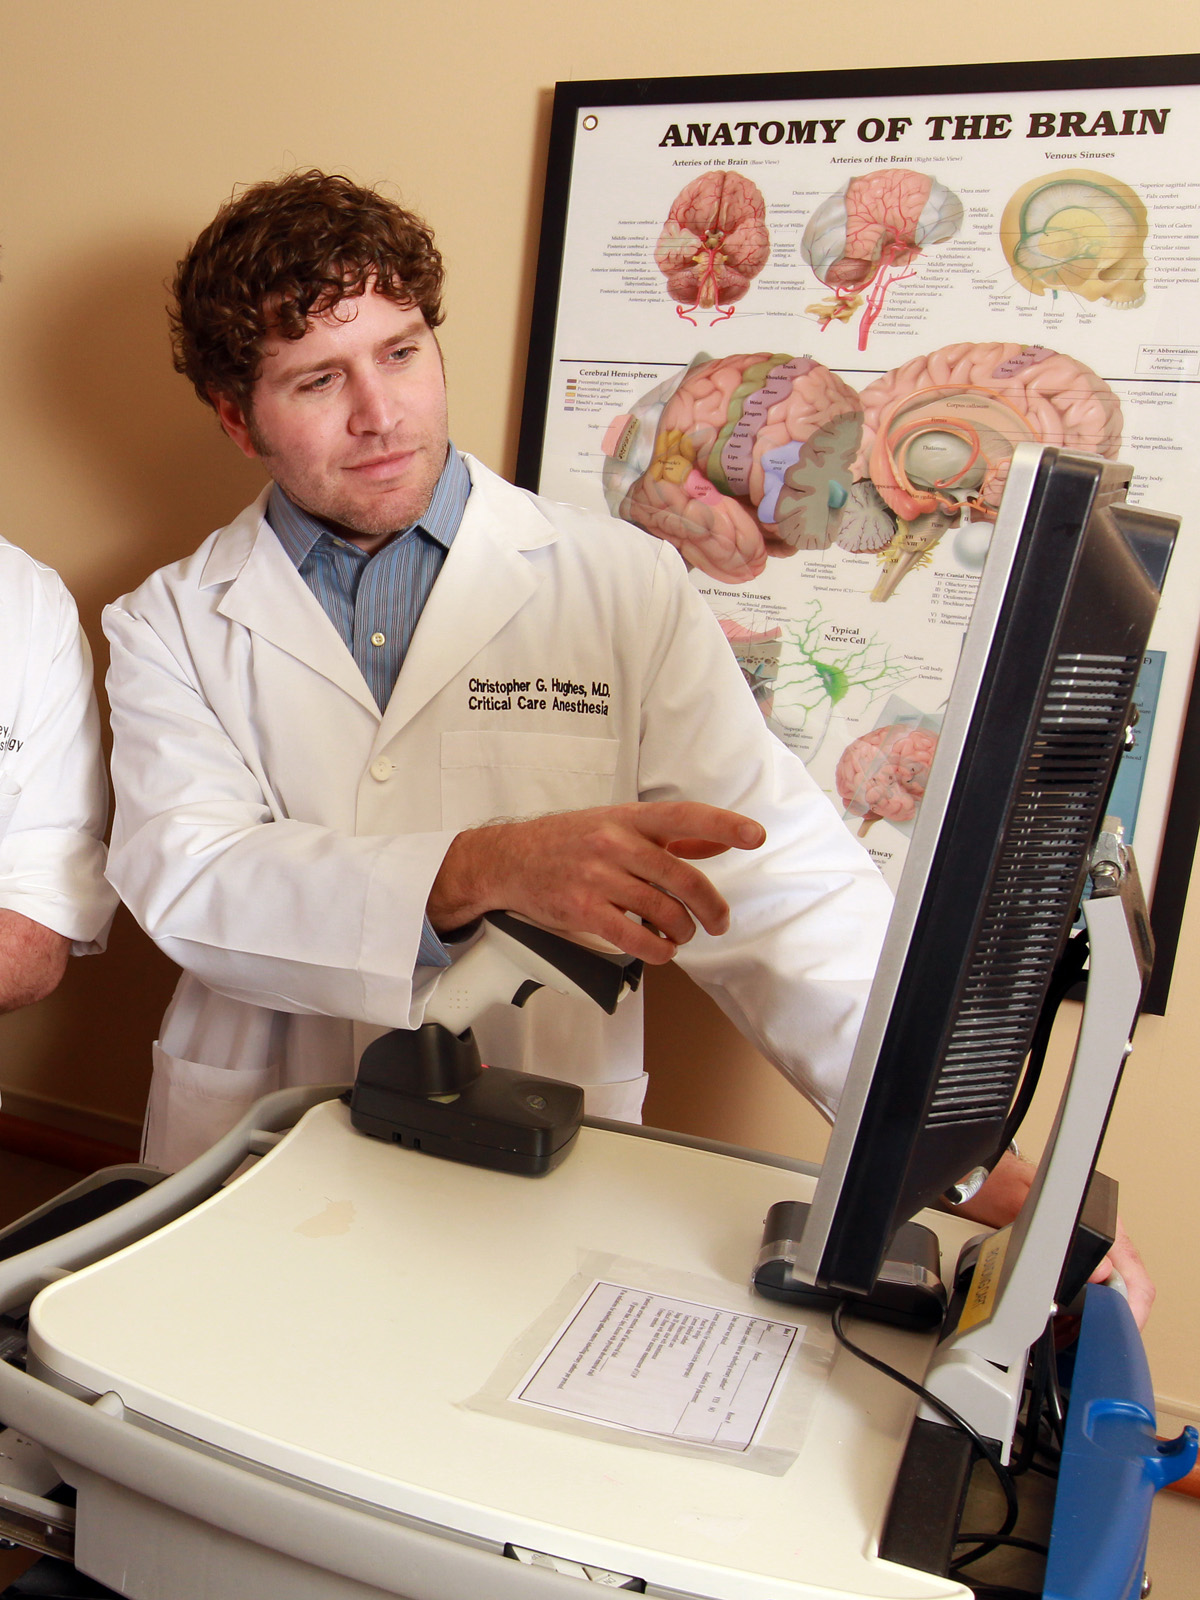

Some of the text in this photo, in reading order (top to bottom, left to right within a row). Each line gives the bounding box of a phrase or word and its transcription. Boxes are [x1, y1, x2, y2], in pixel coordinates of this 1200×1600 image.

[658, 108, 1172, 147] ANATOMY OF THE BRAIN
[829, 156, 862, 164] Arteries
[864, 155, 873, 164] of
[875, 155, 888, 163] the
[889, 155, 913, 163] Brain
[1044, 151, 1115, 160] Venous Sinuses
[672, 159, 702, 167] Arteries
[703, 158, 712, 166] of
[713, 158, 726, 166] the
[727, 158, 748, 166] Brain
[579, 369, 658, 379] Cerebral Hemispheres
[713, 589, 740, 598] Venous
[742, 592, 771, 601] Sinuses
[831, 626, 860, 636] Typical
[824, 634, 866, 645] Nerve Cell
[468, 677, 531, 696] Christopher
[535, 678, 548, 692] G.
[551, 678, 587, 698] Hughes,
[468, 696, 609, 716] Critical Care Anesthesia
